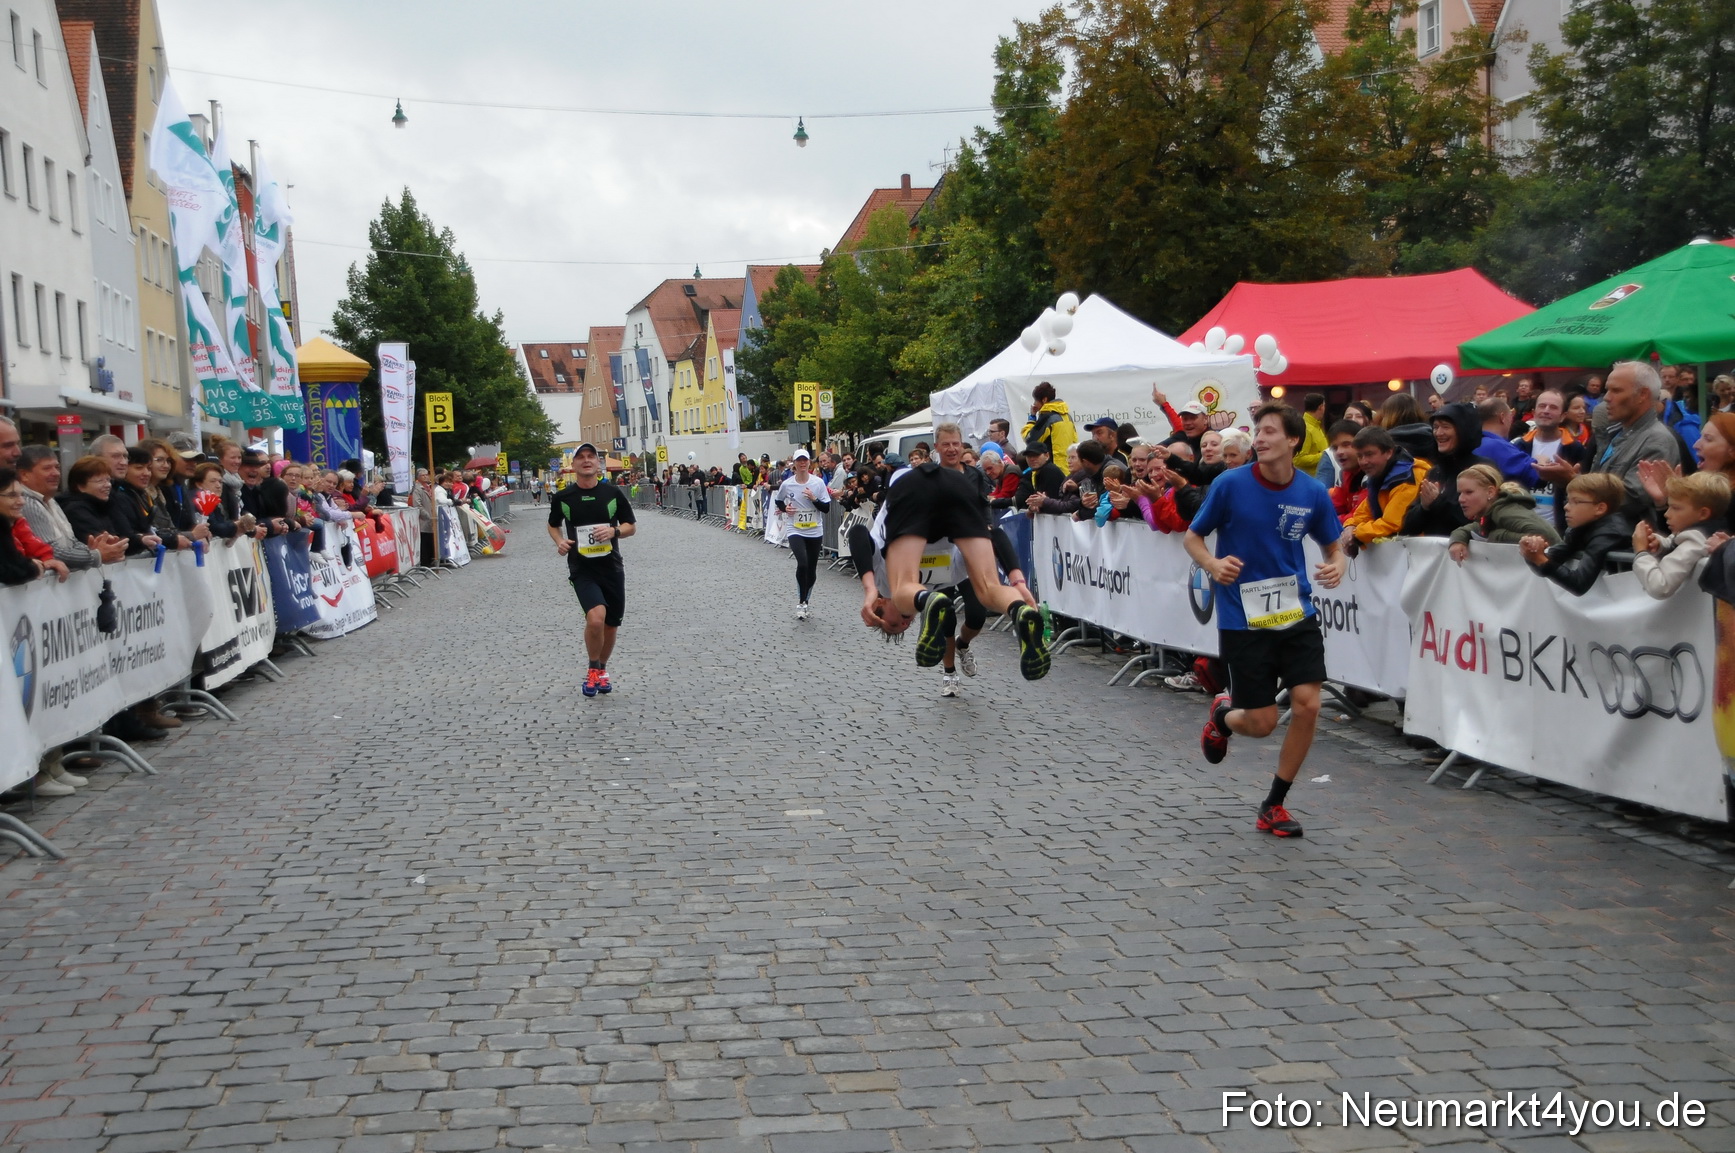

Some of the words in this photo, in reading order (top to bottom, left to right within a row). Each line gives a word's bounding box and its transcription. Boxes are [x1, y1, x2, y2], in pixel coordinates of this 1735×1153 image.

[801, 394, 813, 412] B
[433, 405, 447, 423] B
[1134, 406, 1156, 419] Sie.
[659, 451, 666, 459] C
[798, 513, 812, 521] 217
[1241, 586, 1260, 594] PARTL
[1261, 582, 1288, 592] Neumarkt
[1260, 590, 1281, 612] 77
[1312, 594, 1359, 638] sport
[42, 615, 75, 667] BMW
[1420, 611, 1488, 675] Audi
[1500, 627, 1589, 699] BKK
